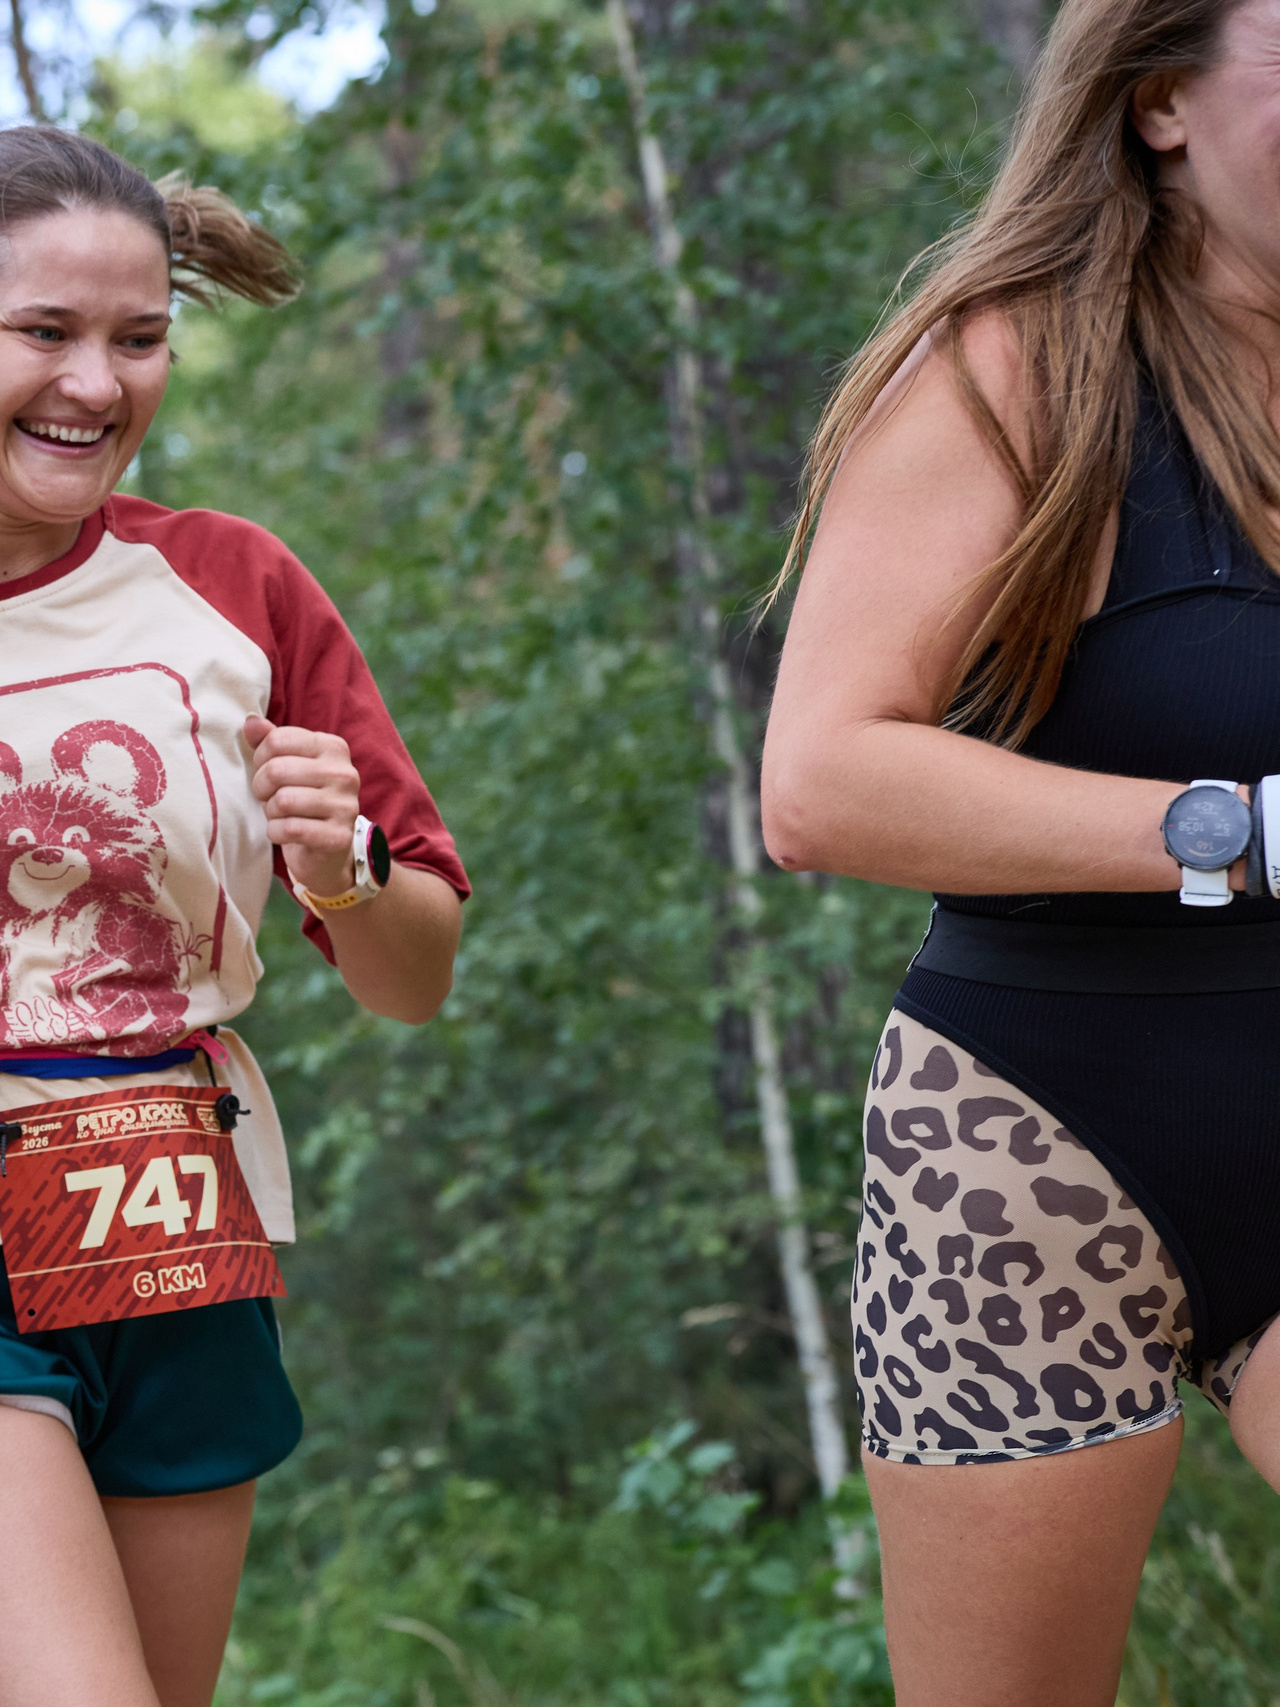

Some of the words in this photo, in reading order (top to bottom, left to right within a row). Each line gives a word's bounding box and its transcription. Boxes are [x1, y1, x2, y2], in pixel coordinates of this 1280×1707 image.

[76, 1107, 137, 1132] РЕТРО
[139, 1103, 187, 1122] КРОСС
[22, 1136, 49, 1150] 2026
[93, 1126, 116, 1140] дню
[64, 1154, 218, 1250] 747
[132, 1272, 155, 1298] 6
